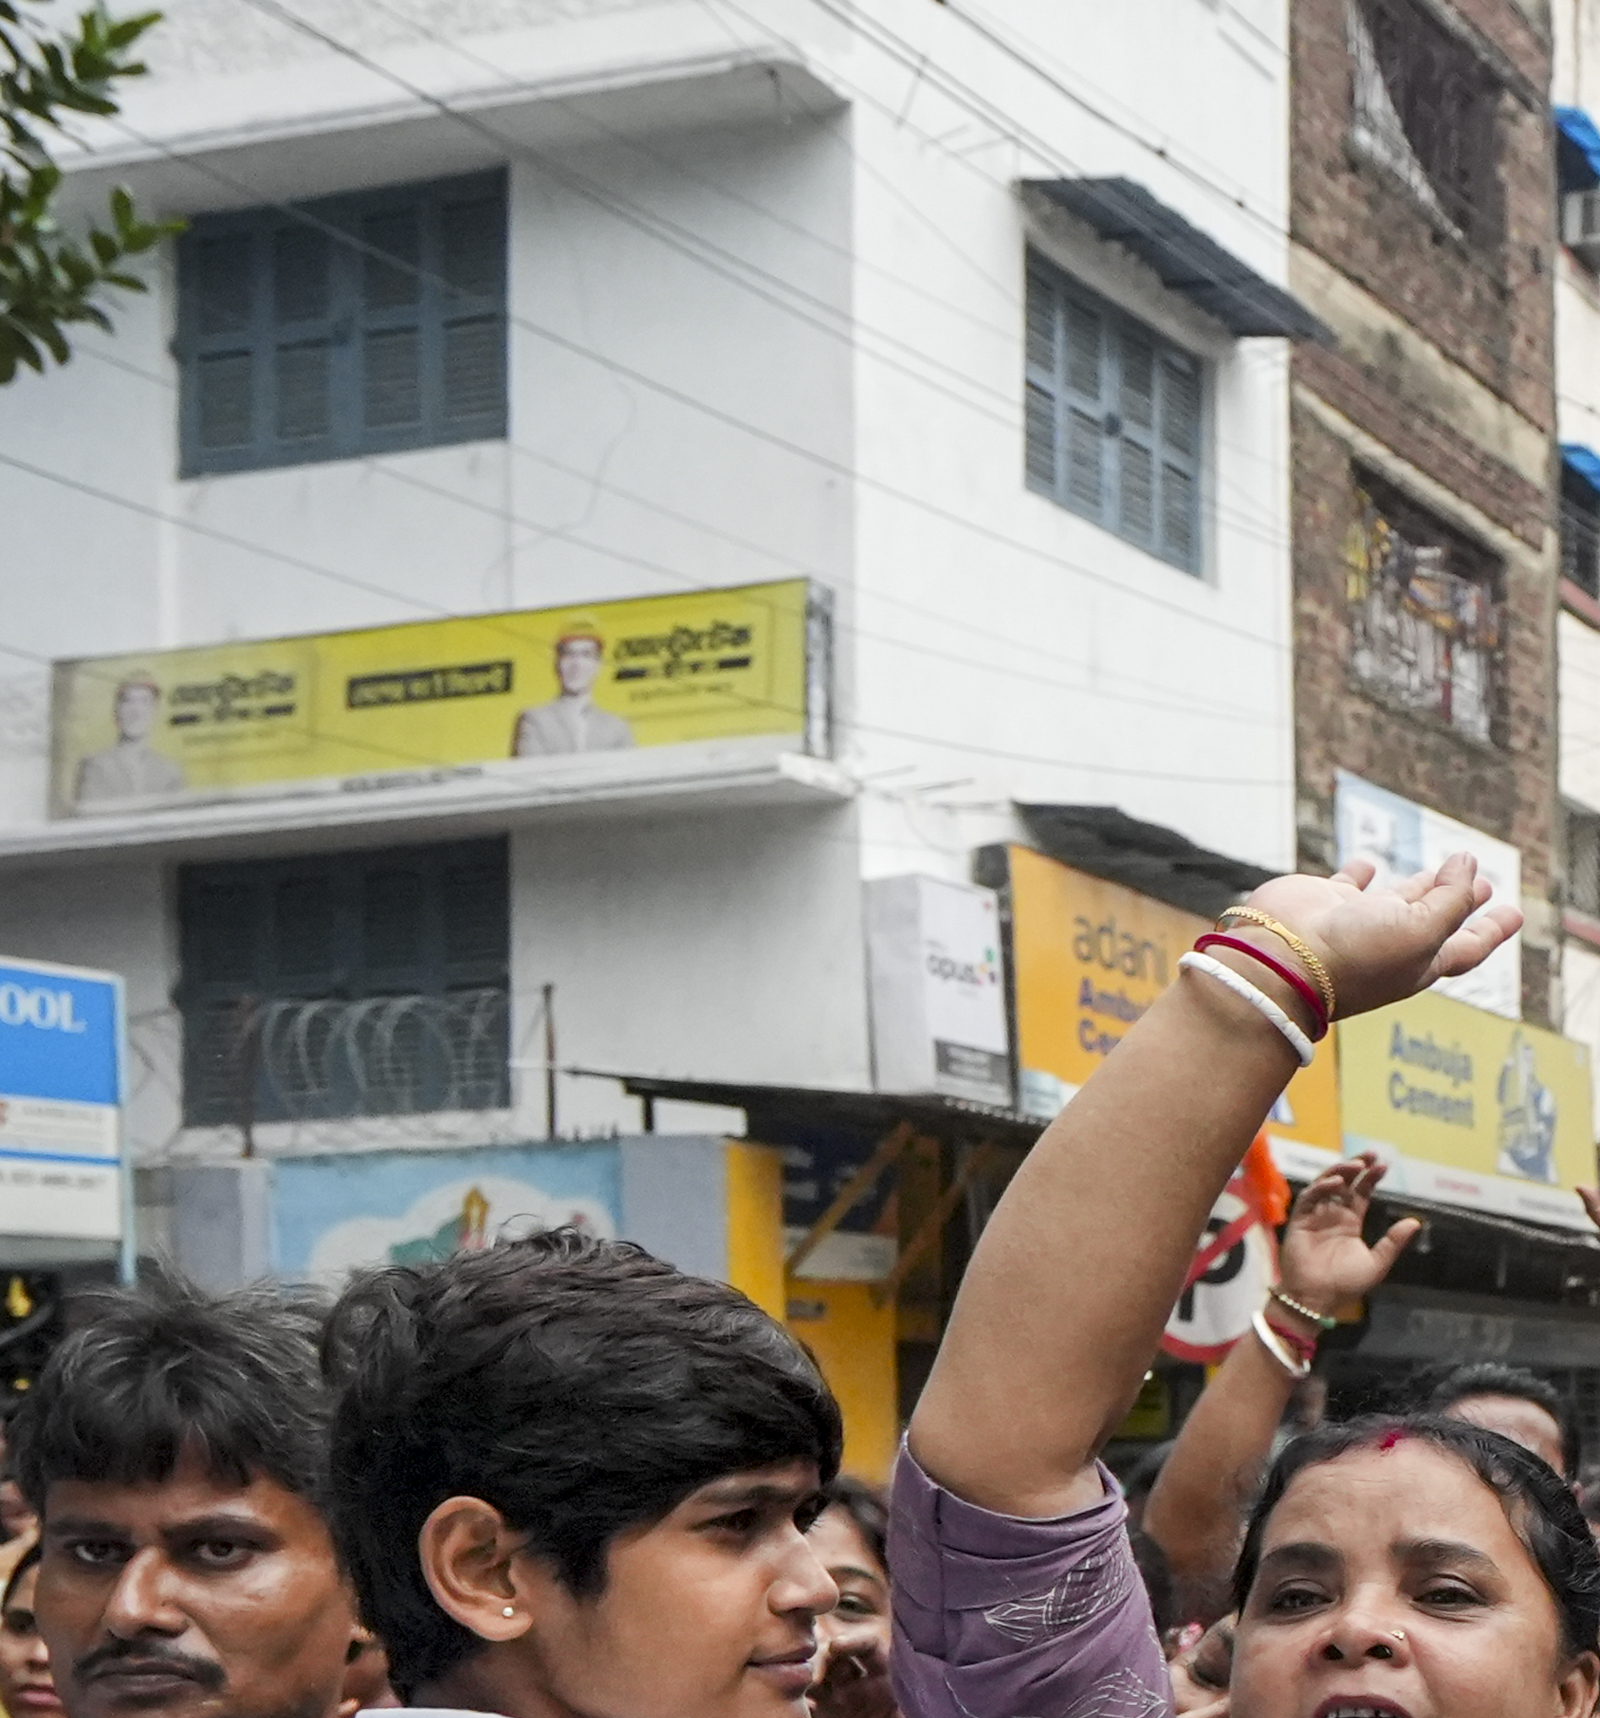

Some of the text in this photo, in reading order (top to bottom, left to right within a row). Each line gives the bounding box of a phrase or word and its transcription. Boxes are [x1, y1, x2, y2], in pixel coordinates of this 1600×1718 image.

[1073, 915, 1169, 987] adani
[1390, 1022, 1474, 1088] Ambuja
[1389, 1070, 1475, 1130] Cement
